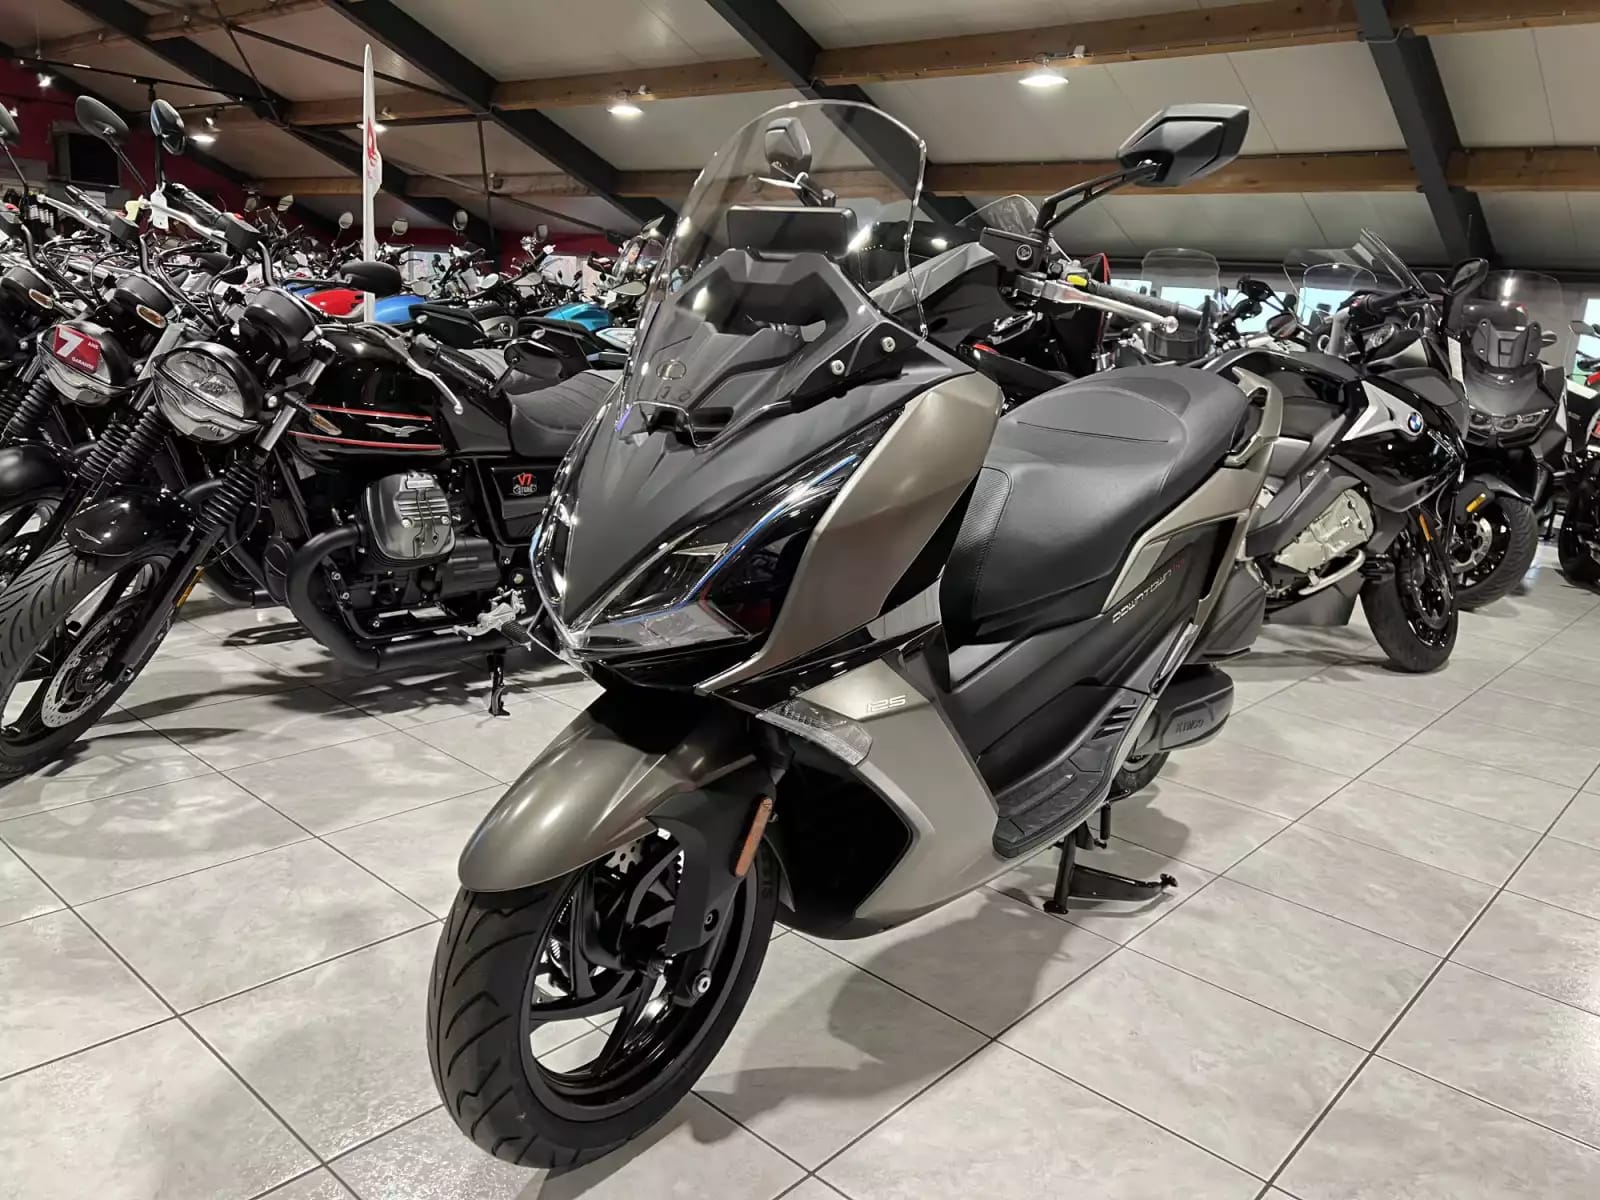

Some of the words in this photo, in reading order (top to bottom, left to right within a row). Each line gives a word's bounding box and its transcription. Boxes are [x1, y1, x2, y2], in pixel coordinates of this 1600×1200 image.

[56, 327, 85, 358] 7
[517, 473, 533, 486] V7
[864, 694, 906, 712] 125
